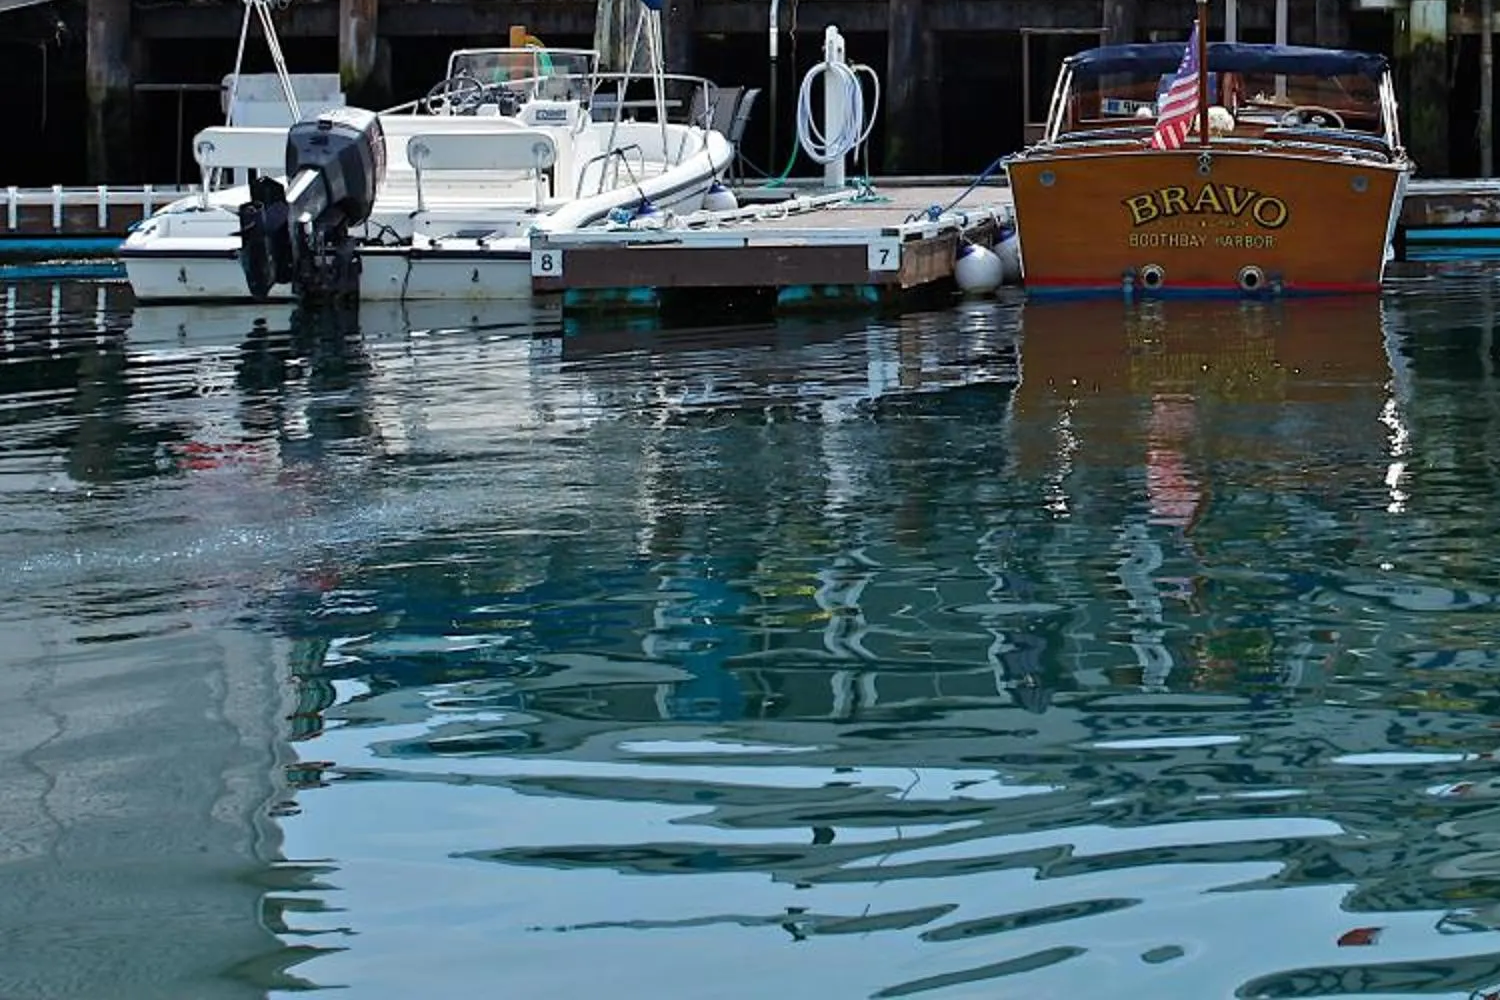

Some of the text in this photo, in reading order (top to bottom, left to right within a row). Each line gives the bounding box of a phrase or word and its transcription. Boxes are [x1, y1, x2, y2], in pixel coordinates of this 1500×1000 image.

[1124, 180, 1289, 230] BRAVO
[1129, 233, 1275, 249] BOOTHBAY HARBOR
[541, 253, 553, 271] 8
[879, 249, 890, 265] 7
